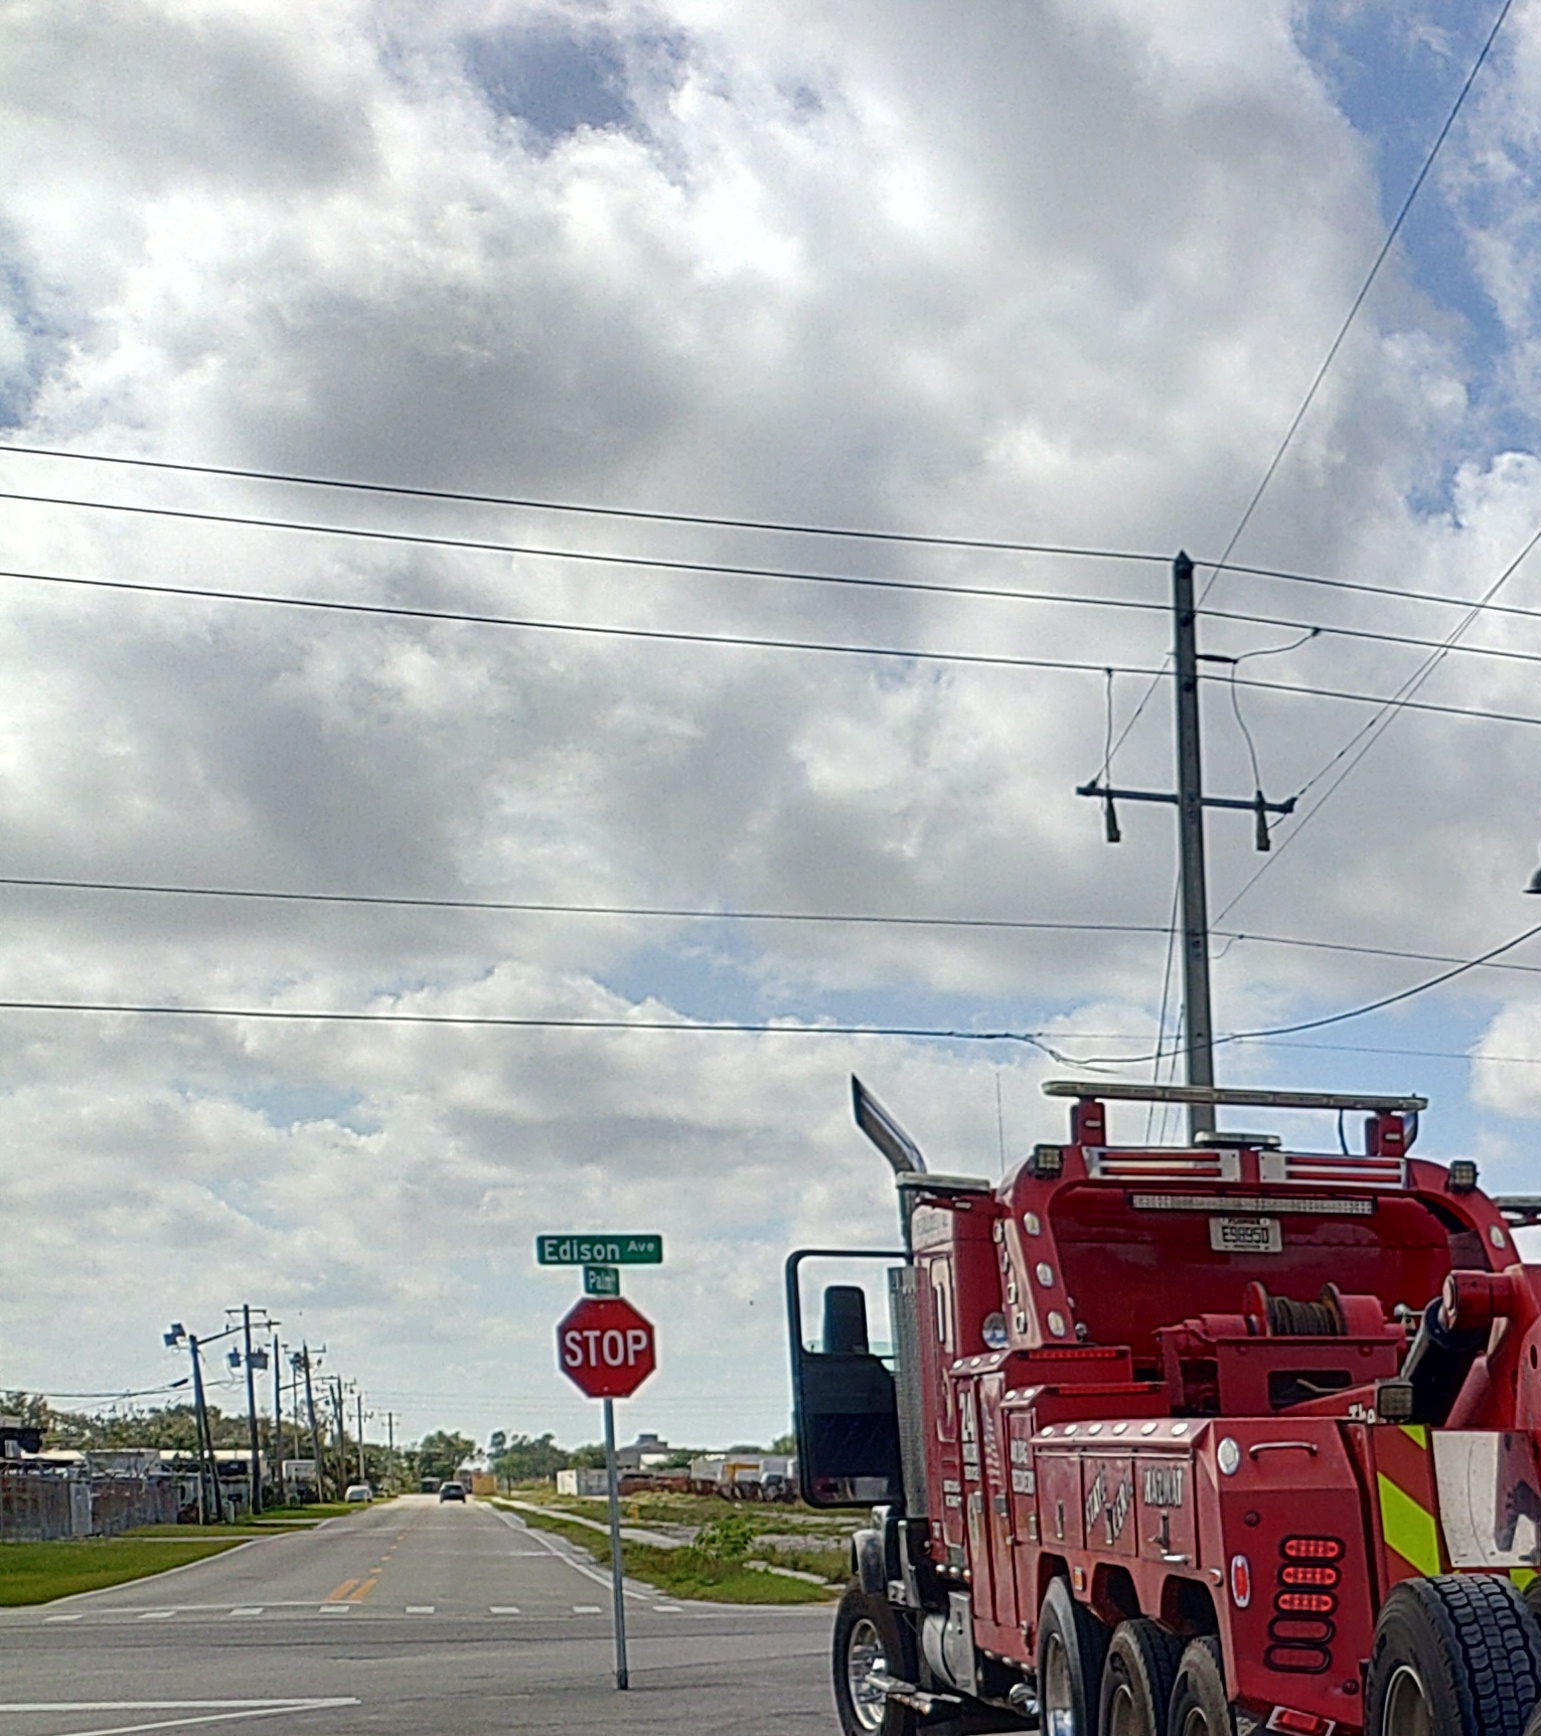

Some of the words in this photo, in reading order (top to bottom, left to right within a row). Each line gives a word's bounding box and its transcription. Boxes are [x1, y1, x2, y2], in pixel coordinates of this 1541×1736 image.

[544, 1240, 620, 1261] Edison
[627, 1241, 655, 1252] Ave
[565, 1329, 648, 1367] STOP
